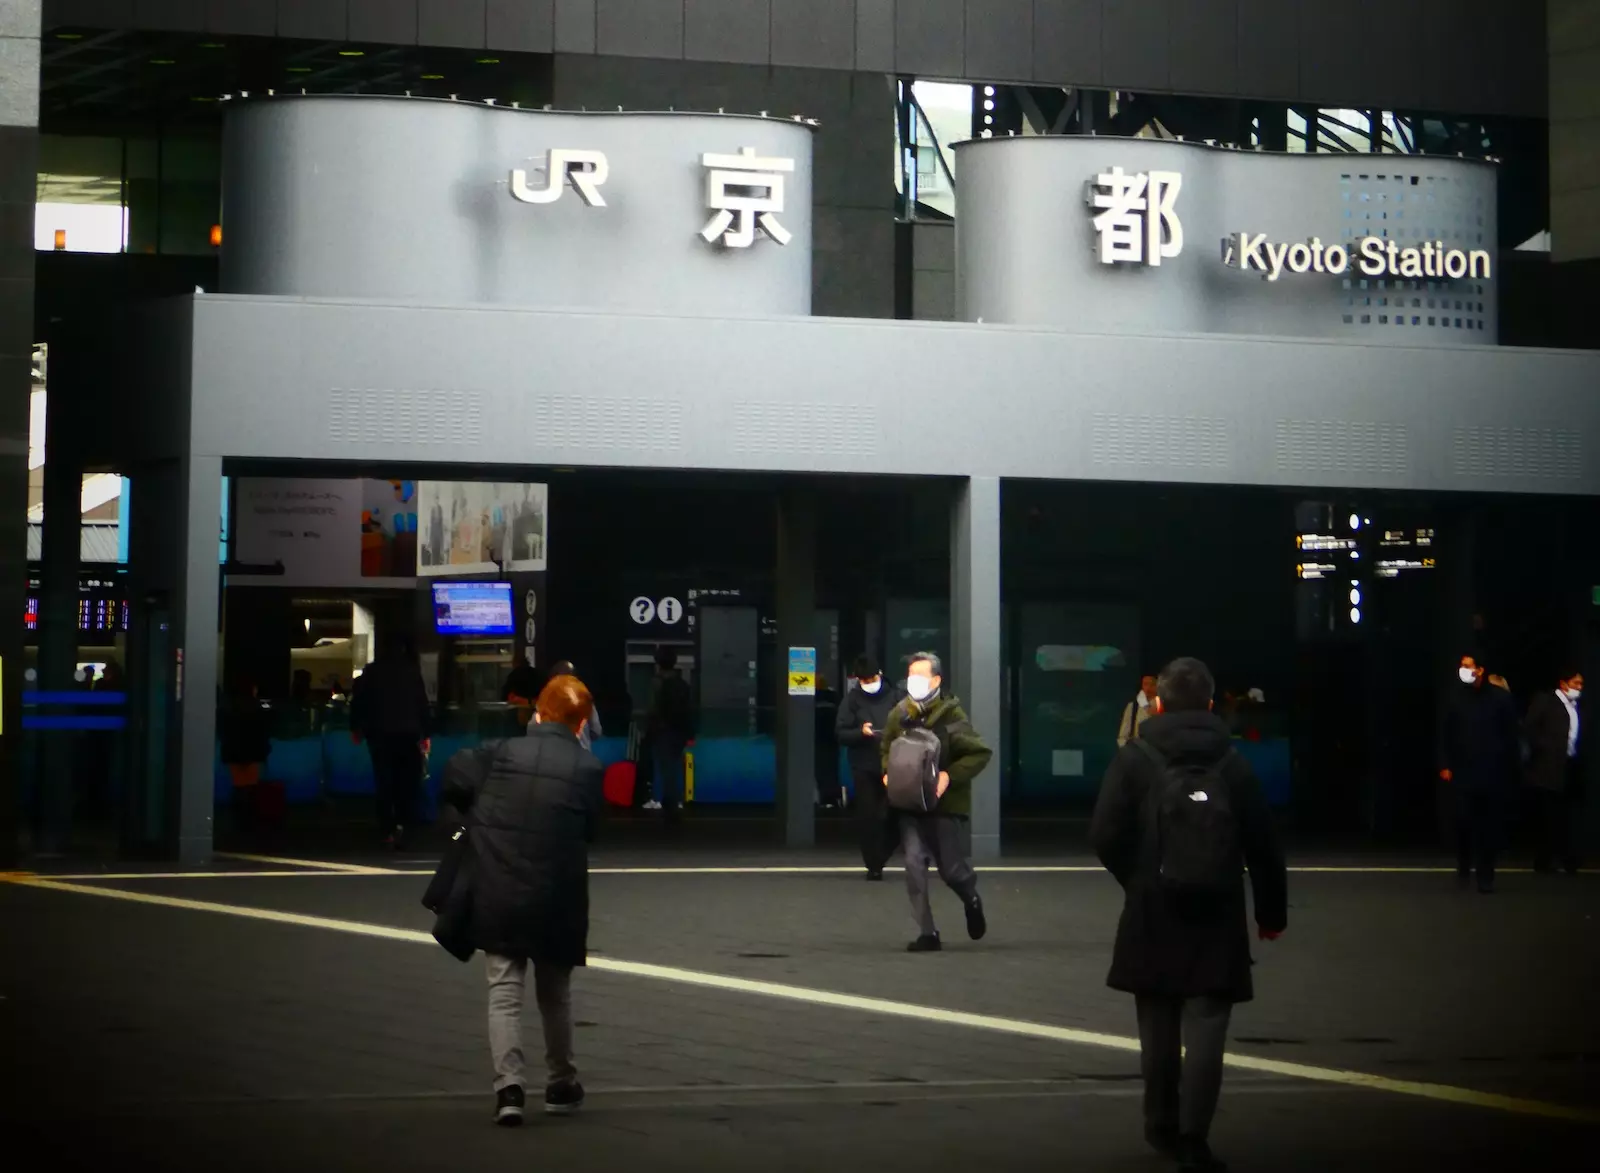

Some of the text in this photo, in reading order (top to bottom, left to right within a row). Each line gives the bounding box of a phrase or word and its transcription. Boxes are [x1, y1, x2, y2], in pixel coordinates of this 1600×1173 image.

[510, 148, 609, 207] JR
[699, 146, 795, 248] 京
[1092, 167, 1184, 267] 都
[1239, 232, 1491, 282] Kyoto Station
